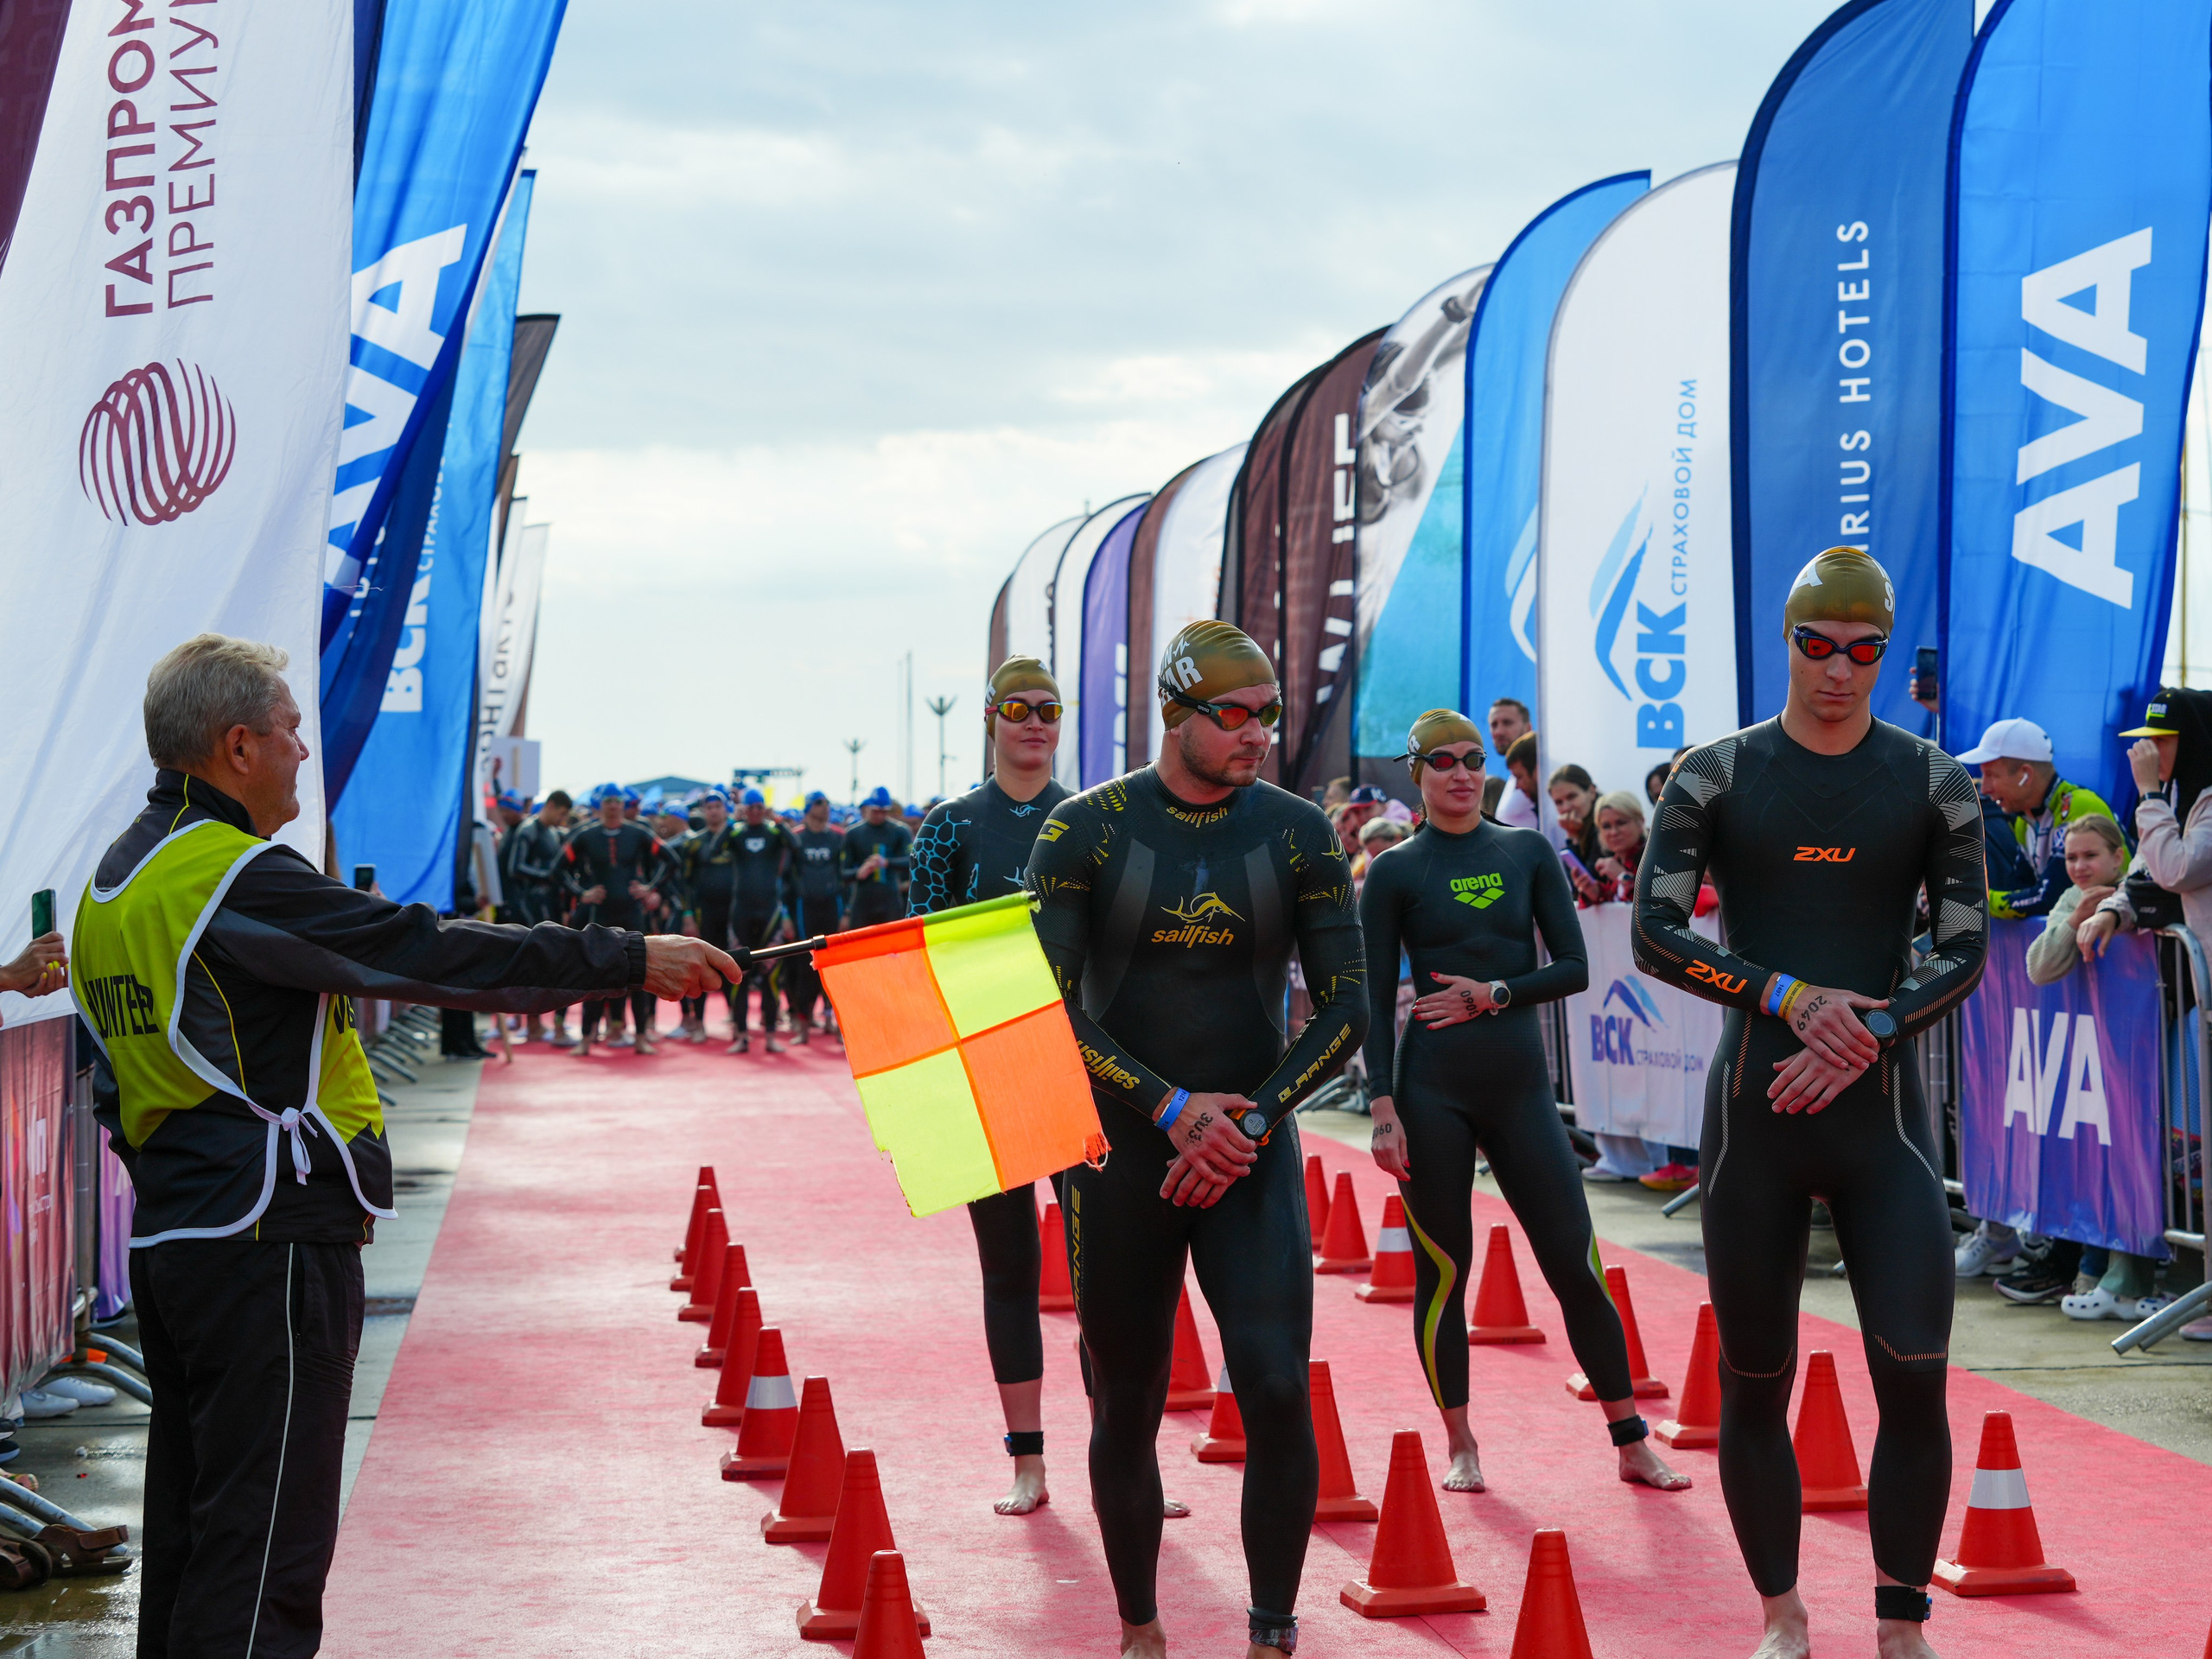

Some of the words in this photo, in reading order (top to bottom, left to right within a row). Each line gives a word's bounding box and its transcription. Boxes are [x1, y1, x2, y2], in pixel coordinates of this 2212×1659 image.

[168, 0, 219, 308] ПРЕМИУ
[1837, 219, 1872, 404] HOTELS
[1676, 378, 1697, 438] ДОМ
[2012, 226, 2152, 610] AVA
[1840, 429, 1872, 557] RIUS
[1670, 447, 1693, 596] СТРАХОВОЙ
[1637, 601, 1687, 748] ВСК
[1197, 704, 1210, 714] arena
[1166, 806, 1229, 828] sailfish
[1793, 846, 1857, 862] 2XU
[1450, 873, 1503, 892] arena
[1151, 925, 1234, 949] sailfish
[1685, 959, 1748, 994] 2XU
[1460, 990, 1479, 1018] 3060
[1796, 995, 1828, 1032] 2049
[1590, 1014, 1635, 1065] ВСК
[2004, 1007, 2112, 1147] AVA
